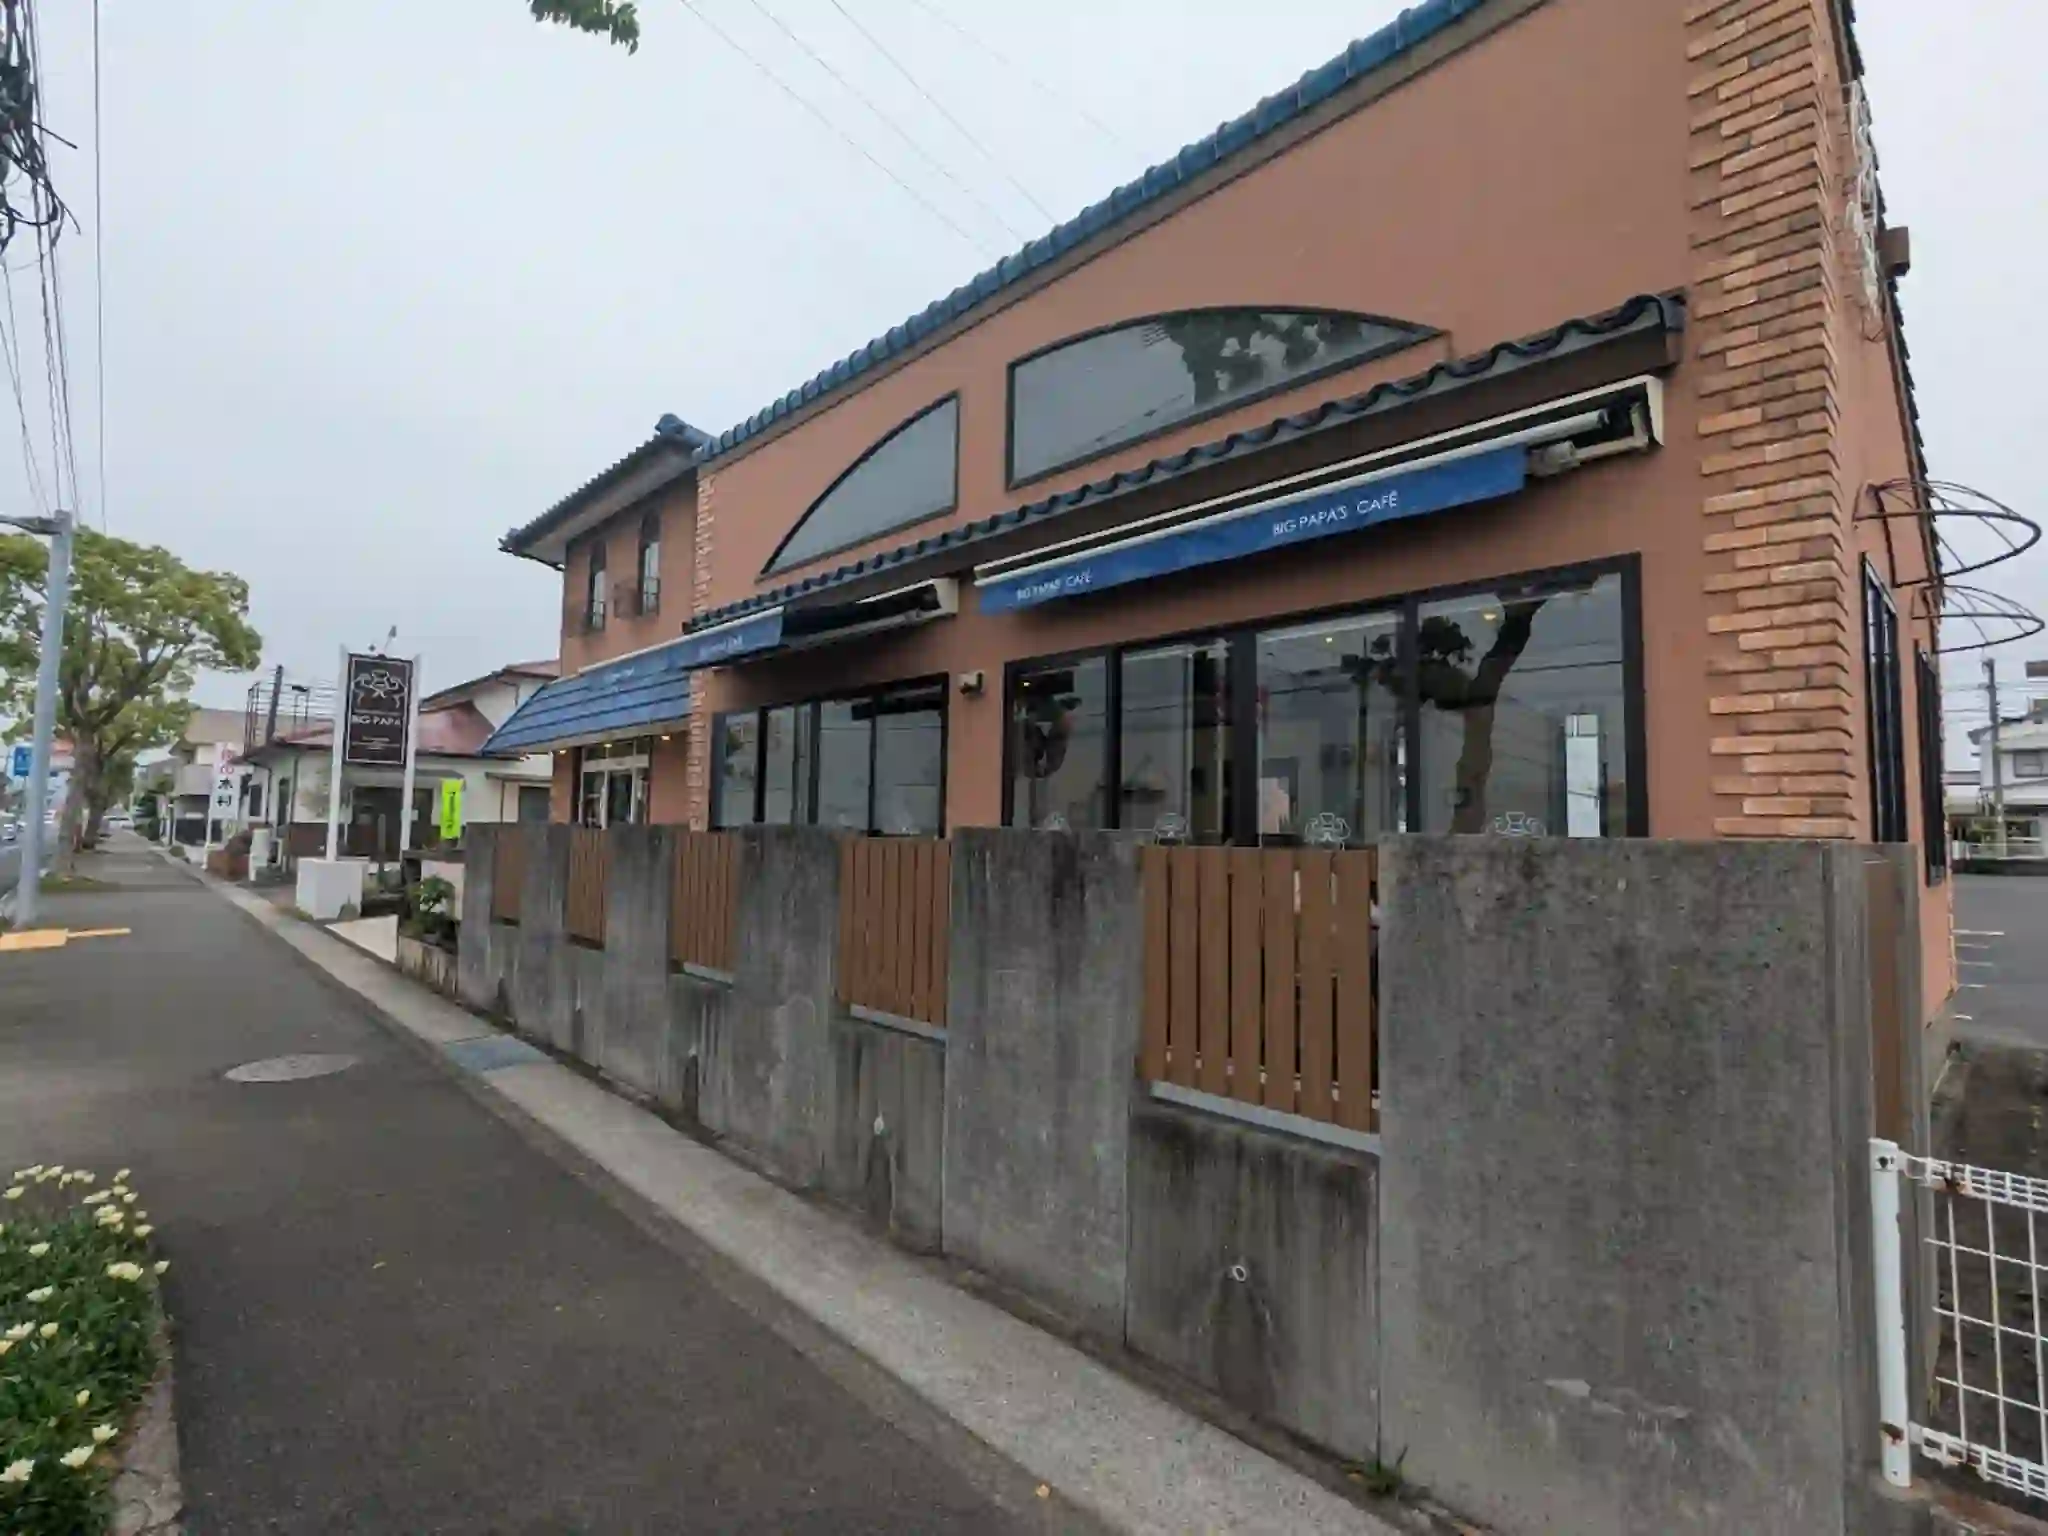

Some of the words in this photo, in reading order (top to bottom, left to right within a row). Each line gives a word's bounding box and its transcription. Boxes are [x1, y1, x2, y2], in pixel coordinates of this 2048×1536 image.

[1273, 519, 1297, 537] BIG
[1299, 505, 1348, 529] PAPA'S
[1356, 490, 1398, 514] CAFÉ
